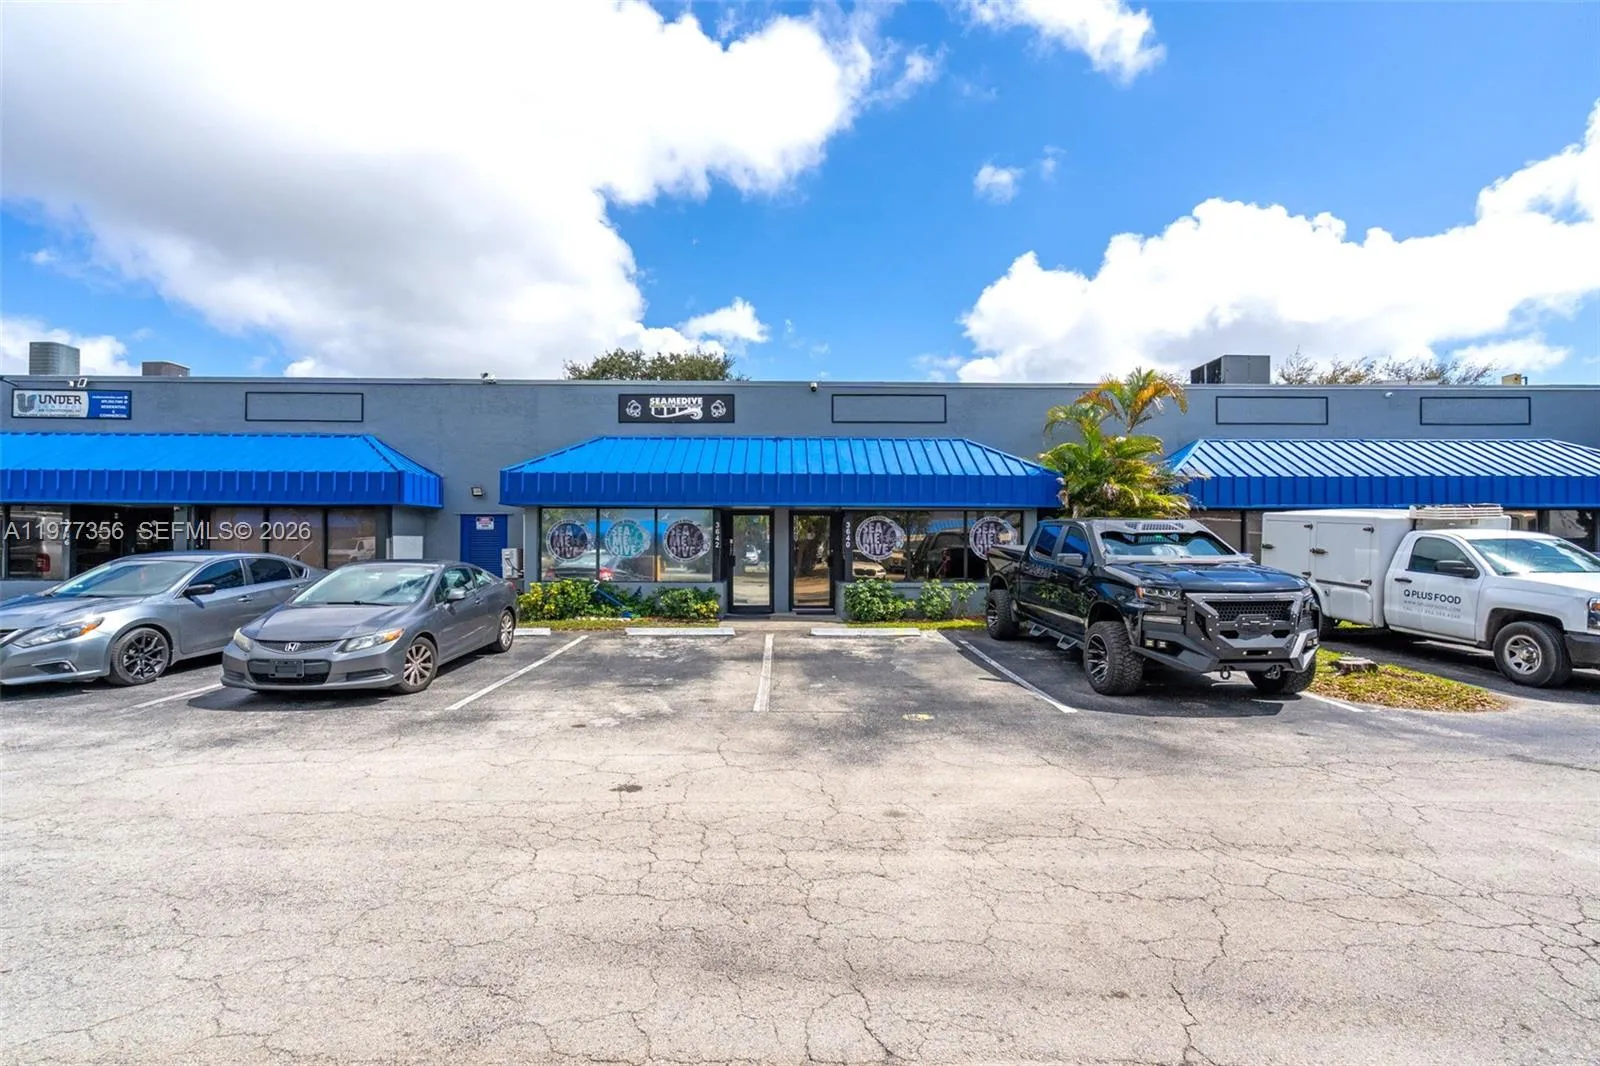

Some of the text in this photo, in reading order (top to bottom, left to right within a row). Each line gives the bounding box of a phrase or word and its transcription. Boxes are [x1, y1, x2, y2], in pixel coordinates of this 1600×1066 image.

[38, 394, 82, 405] UNDER
[649, 397, 703, 405] SEAMEDIVE
[612, 526, 630, 536] SEA
[670, 525, 690, 536] SEA
[862, 522, 883, 534] SEA
[612, 536, 629, 546] ME
[669, 536, 689, 547] ME
[862, 533, 882, 544] ME
[613, 546, 638, 556] DIVE
[669, 546, 697, 558] DIVE
[863, 543, 890, 555] DIVE
[1403, 589, 1461, 604] Q PLUS FOOD
